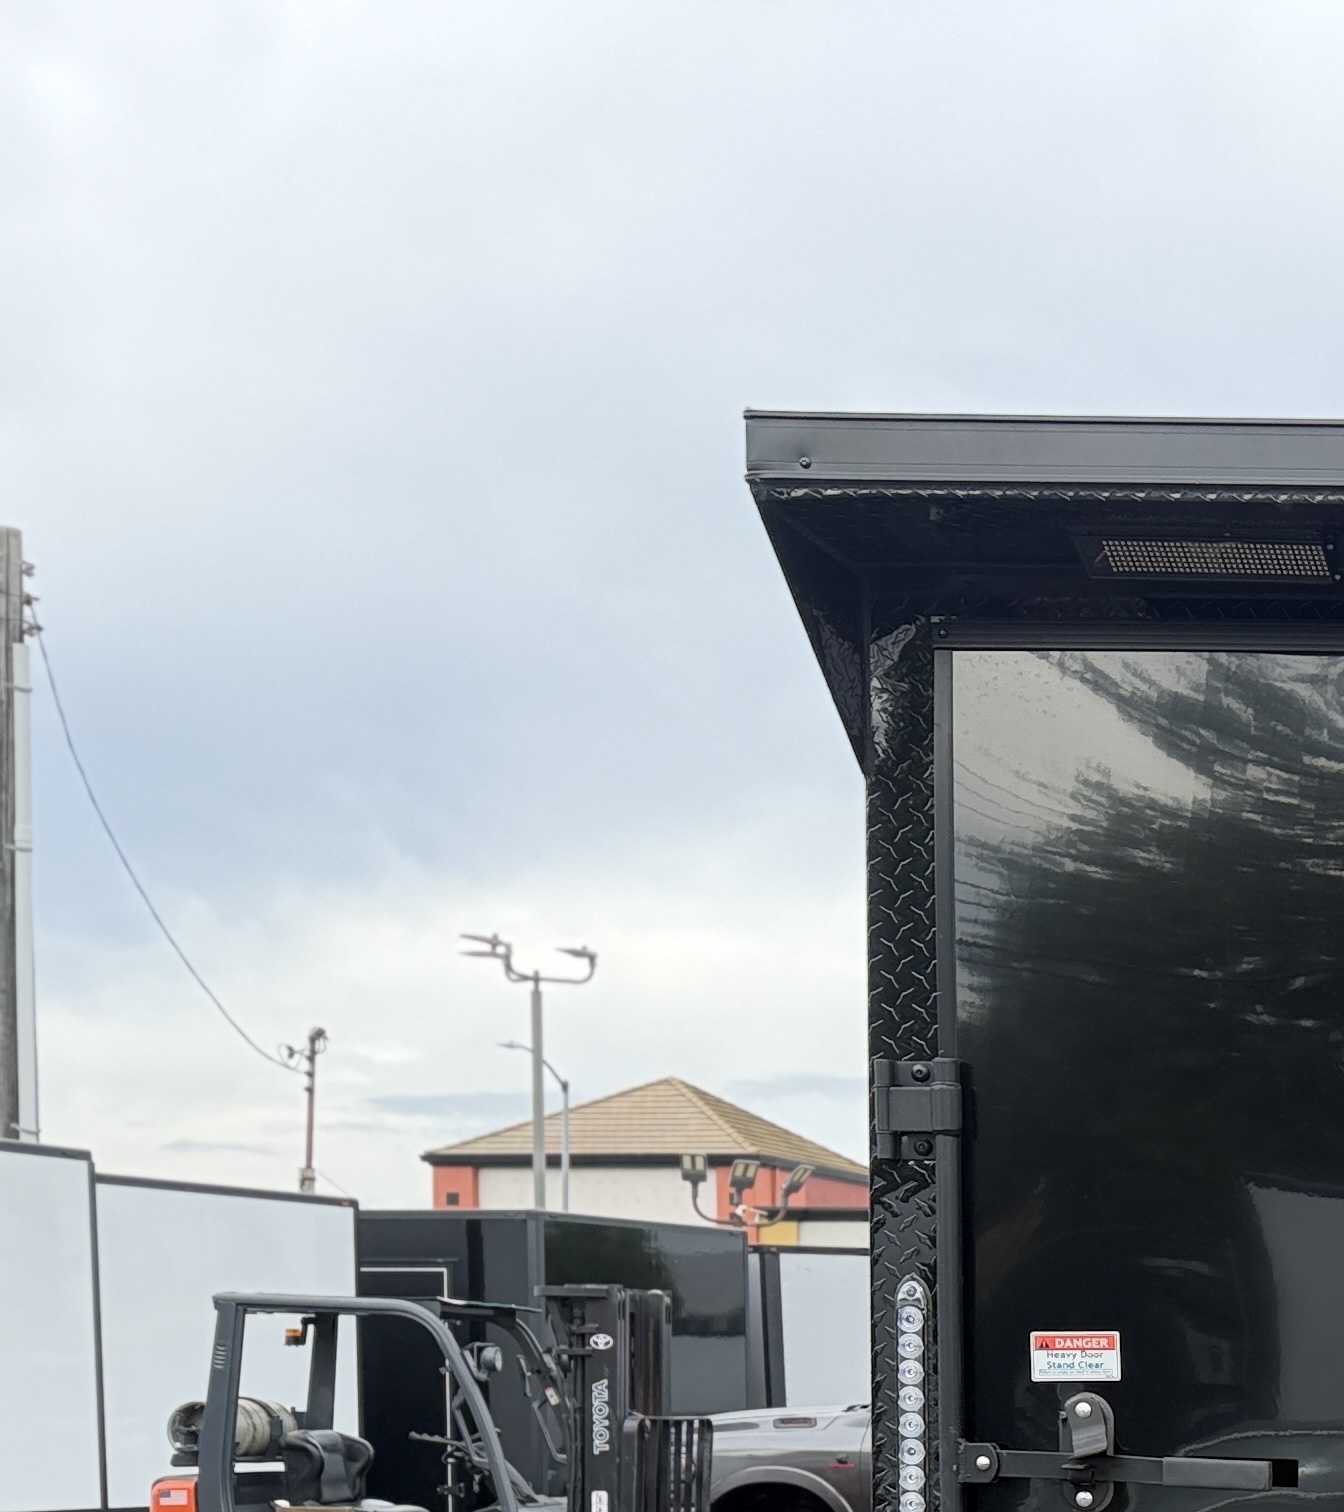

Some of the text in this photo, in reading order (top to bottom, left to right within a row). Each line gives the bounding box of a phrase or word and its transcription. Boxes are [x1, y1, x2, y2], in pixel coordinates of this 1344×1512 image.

[1055, 1337, 1109, 1349] DANGER
[1046, 1350, 1104, 1360] Heavy Door
[1047, 1361, 1105, 1370] Stand Clear
[591, 1378, 610, 1456] TOYOTA
